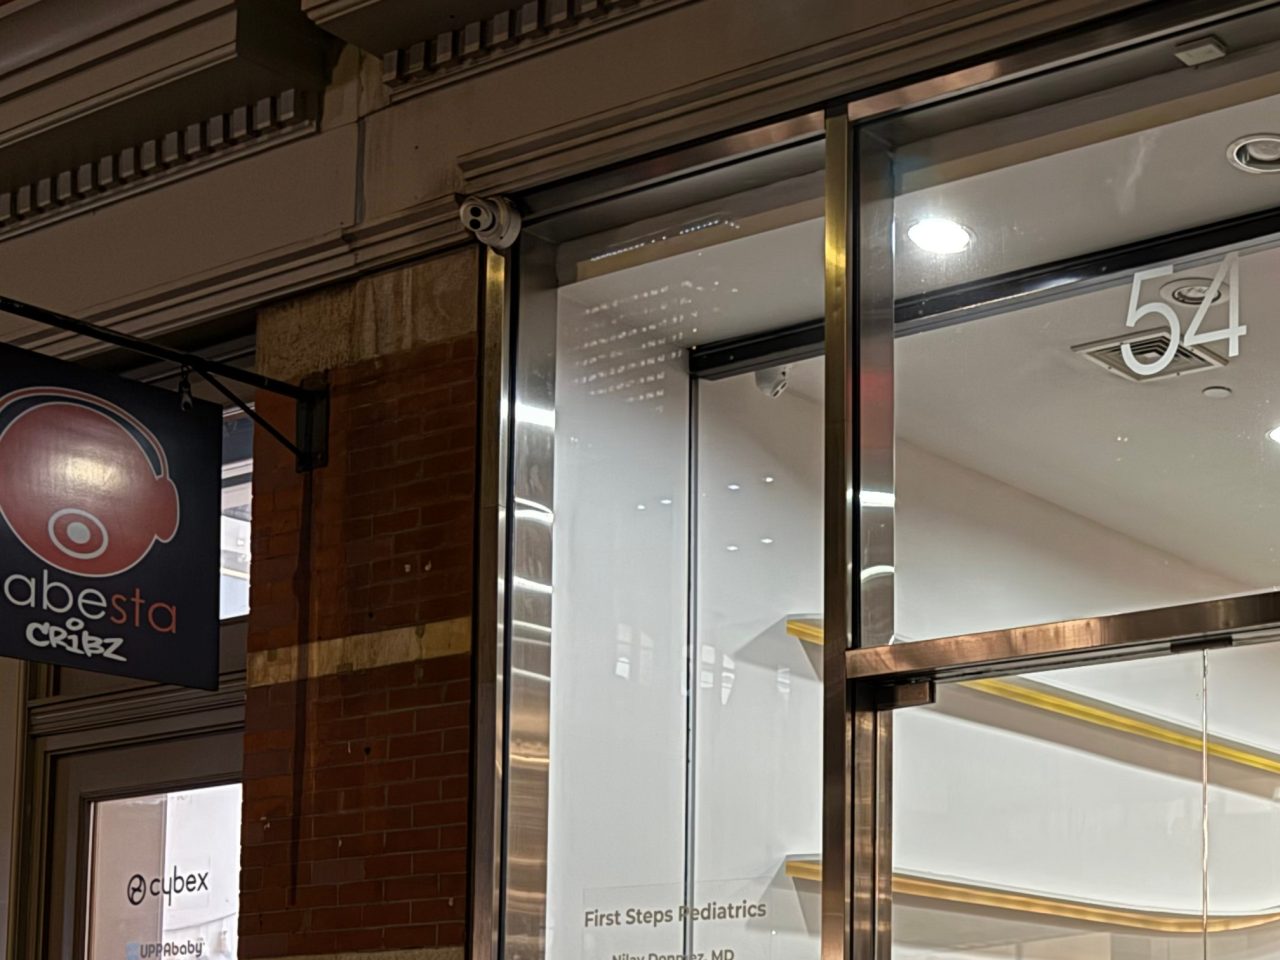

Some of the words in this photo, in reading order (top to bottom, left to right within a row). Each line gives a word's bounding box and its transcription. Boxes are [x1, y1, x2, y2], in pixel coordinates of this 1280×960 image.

[1120, 252, 1247, 376] 54
[4, 569, 177, 634] abesta
[150, 866, 208, 906] cybex
[584, 909, 621, 927] First
[626, 907, 673, 927] Steps
[678, 900, 767, 922] Pediatrics
